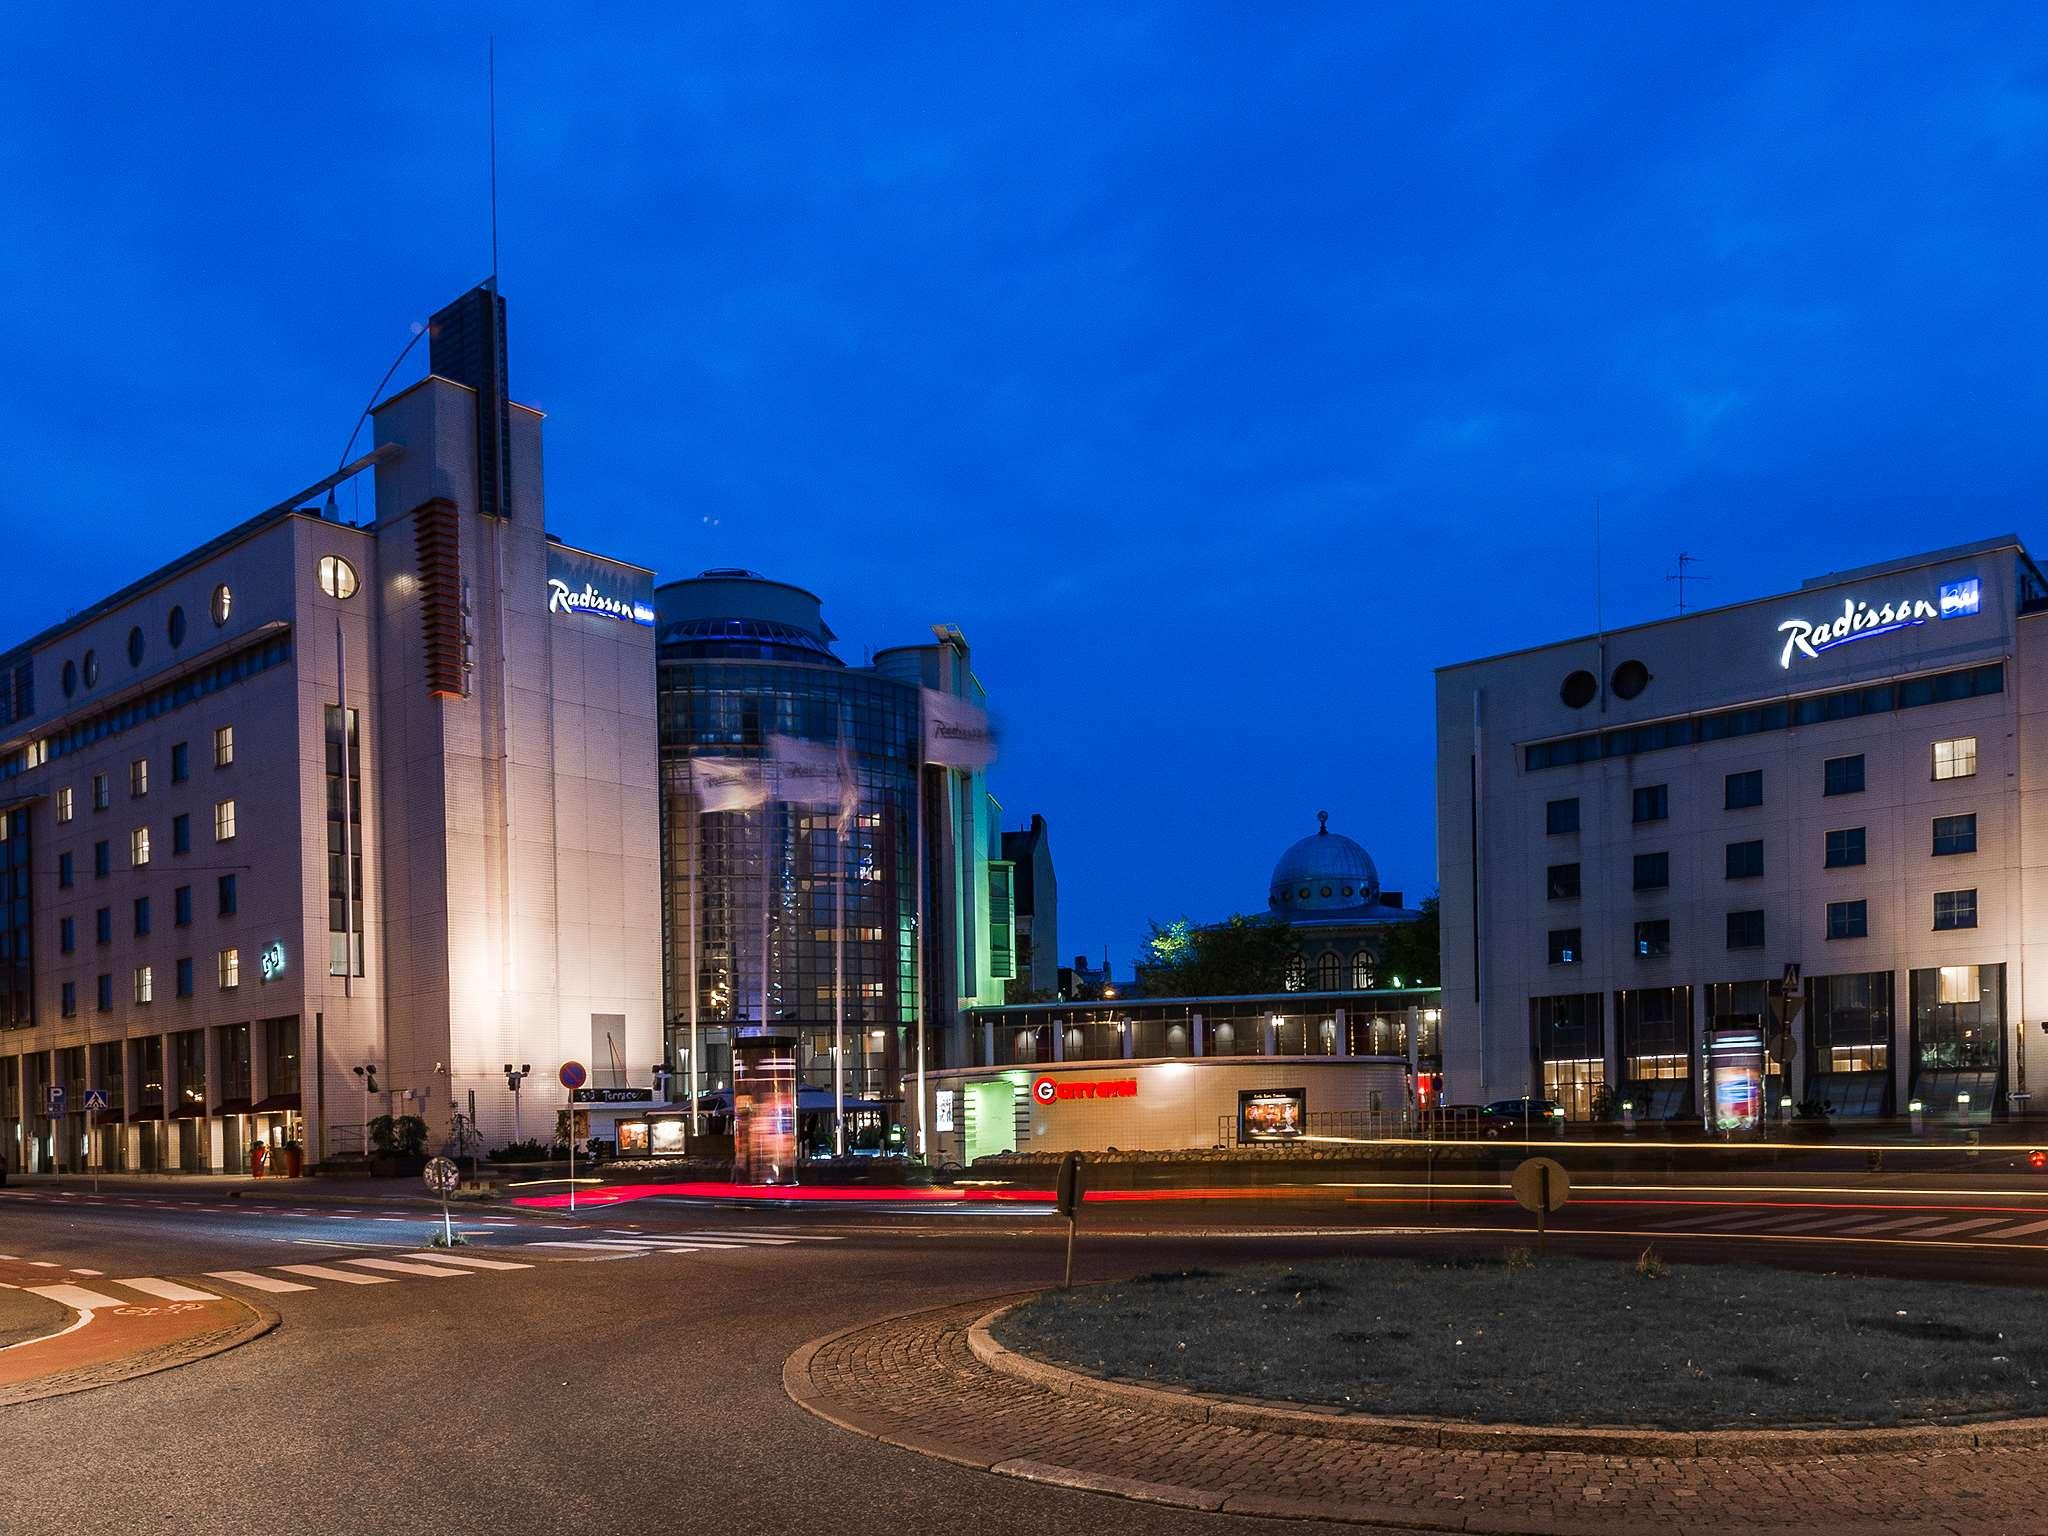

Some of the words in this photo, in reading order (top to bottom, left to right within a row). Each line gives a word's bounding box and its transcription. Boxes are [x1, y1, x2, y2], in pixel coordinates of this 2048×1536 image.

[548, 578, 634, 619] Radisson
[1778, 598, 1938, 669] Radisson
[50, 1088, 63, 1102] P
[1038, 1082, 1054, 1099] G
